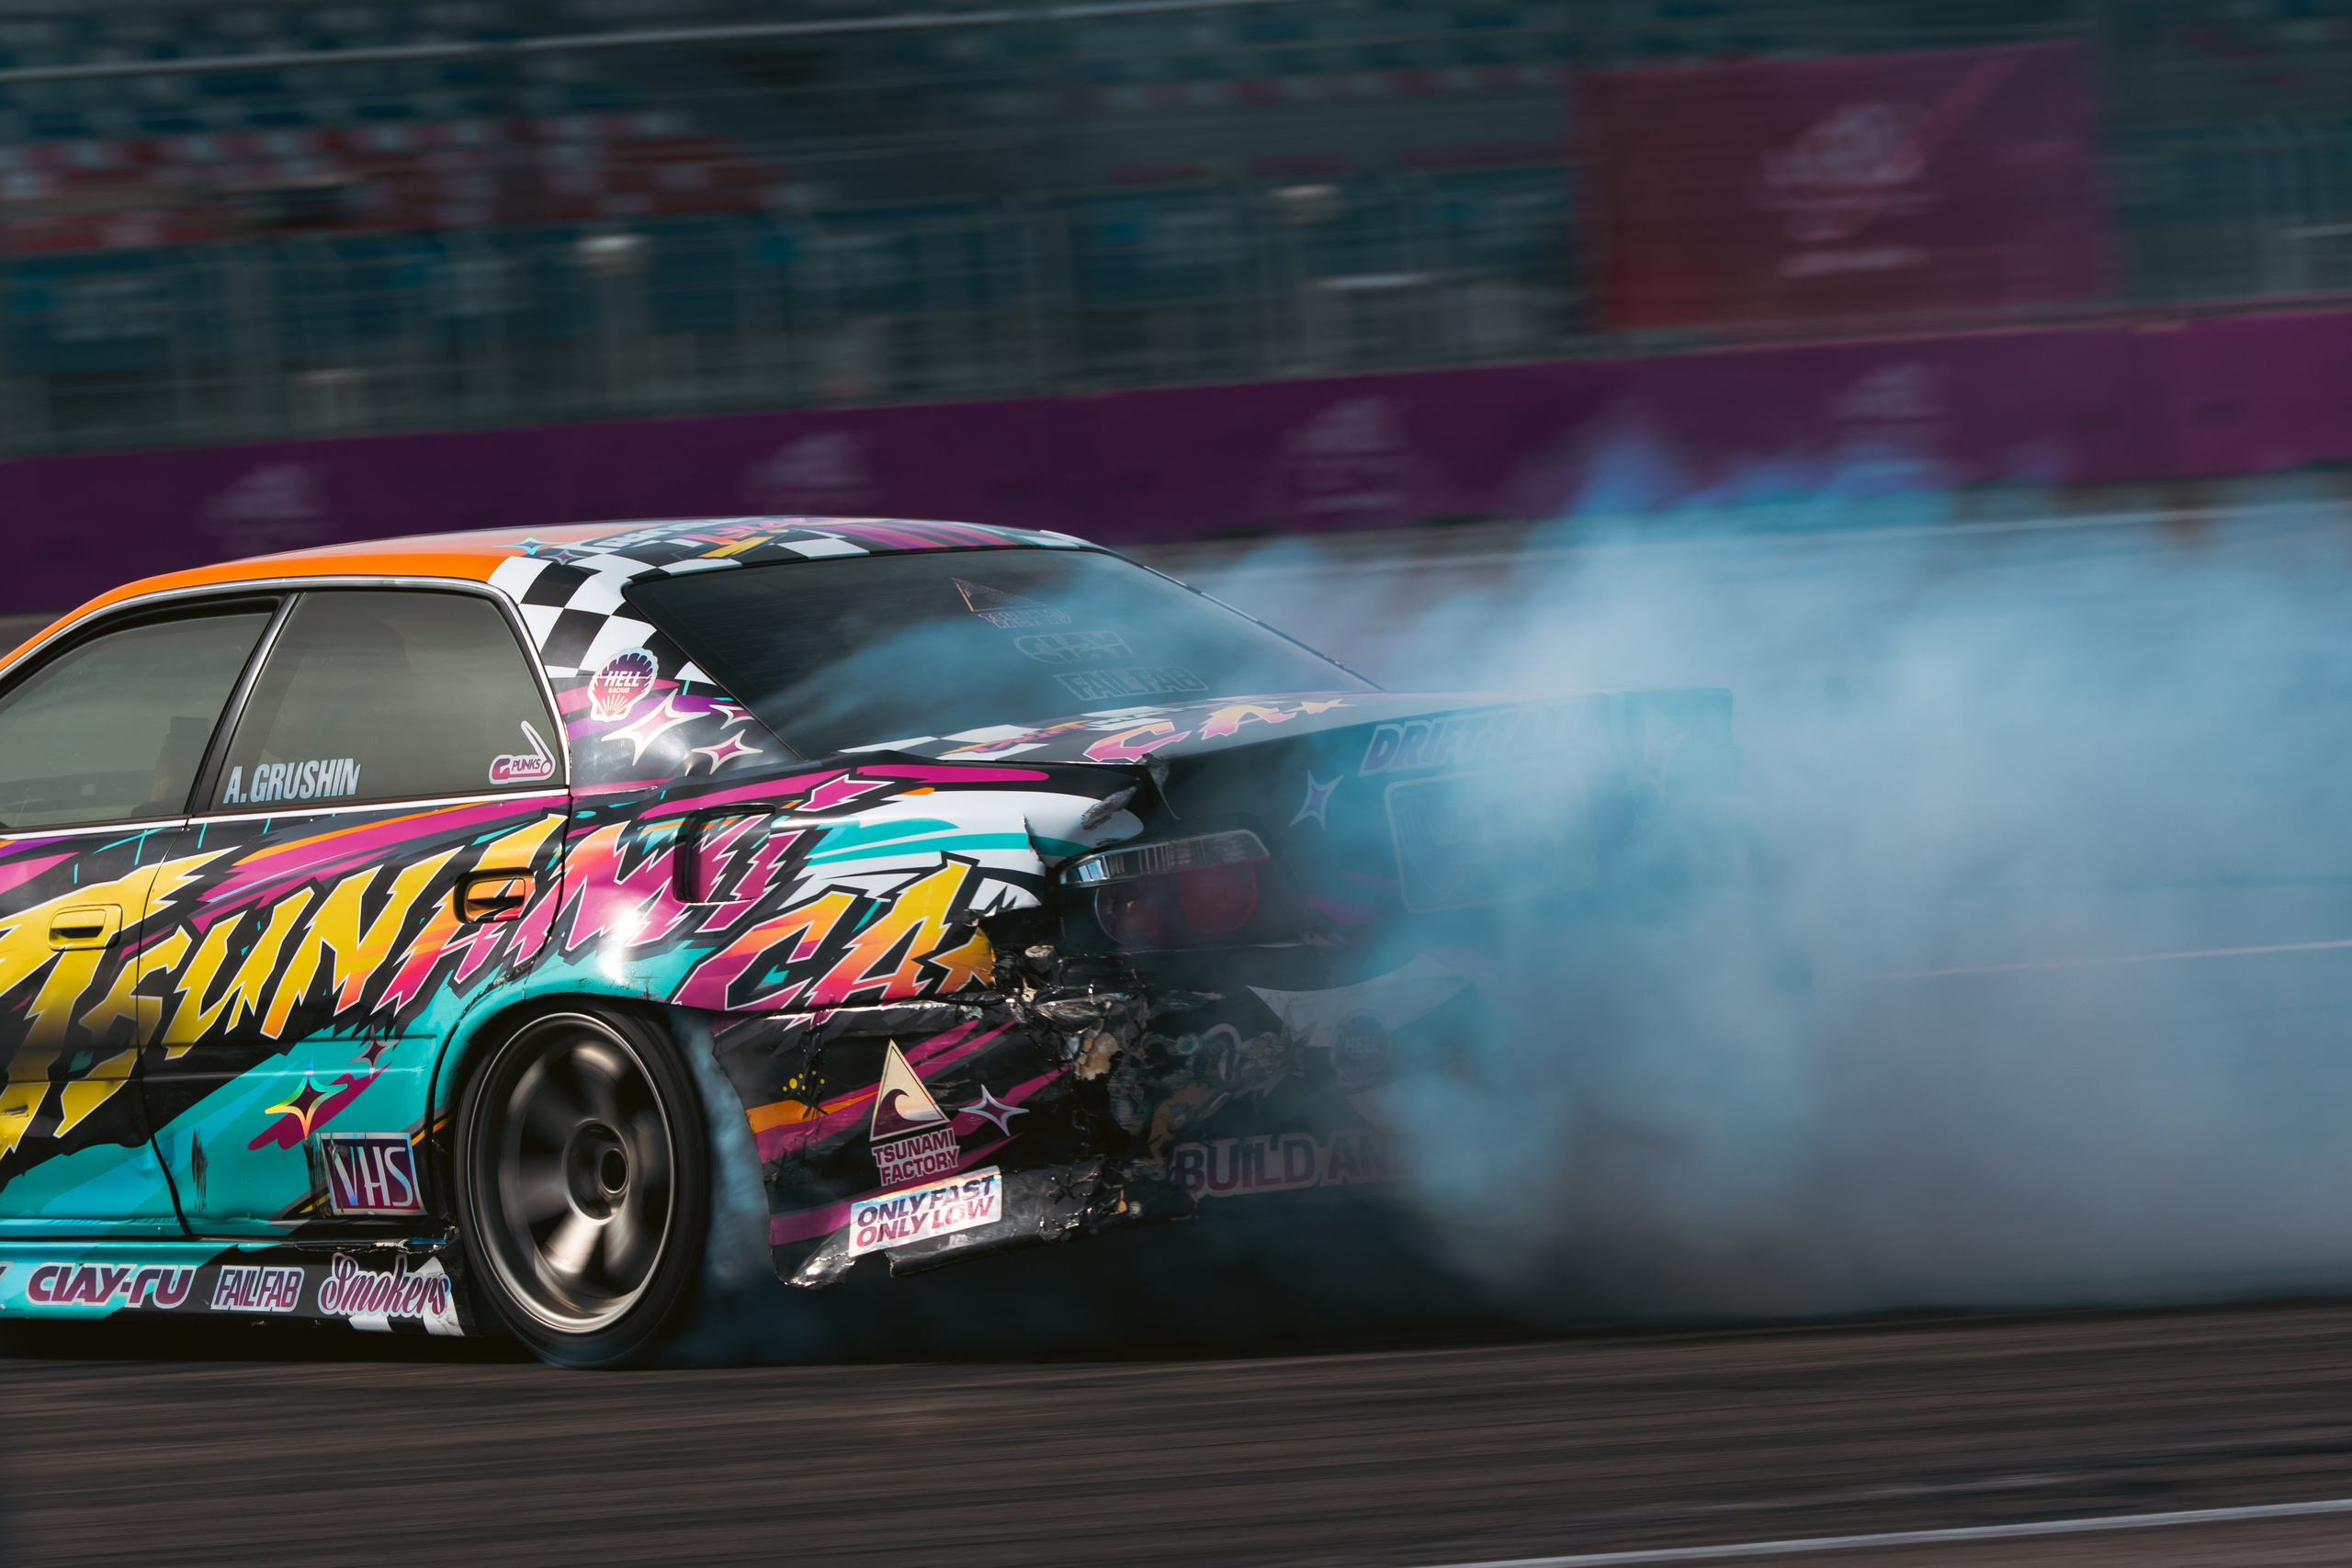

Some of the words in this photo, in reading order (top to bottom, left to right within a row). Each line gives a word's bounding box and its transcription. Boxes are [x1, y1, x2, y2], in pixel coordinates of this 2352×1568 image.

[605, 671, 640, 687] HELL
[512, 759, 541, 772] PUNKS
[874, 1130, 955, 1165] TSUNAMI
[881, 1148, 958, 1184] FACTORY
[1175, 1139, 1316, 1192] BUILD
[333, 1145, 415, 1207] VHS
[856, 1213, 926, 1247] ONLY
[932, 1196, 994, 1229] LOW
[857, 1195, 927, 1226] ONLY
[929, 1176, 996, 1208] FAST
[217, 1269, 301, 1308] FAILFAB
[322, 1256, 449, 1315] Smokers
